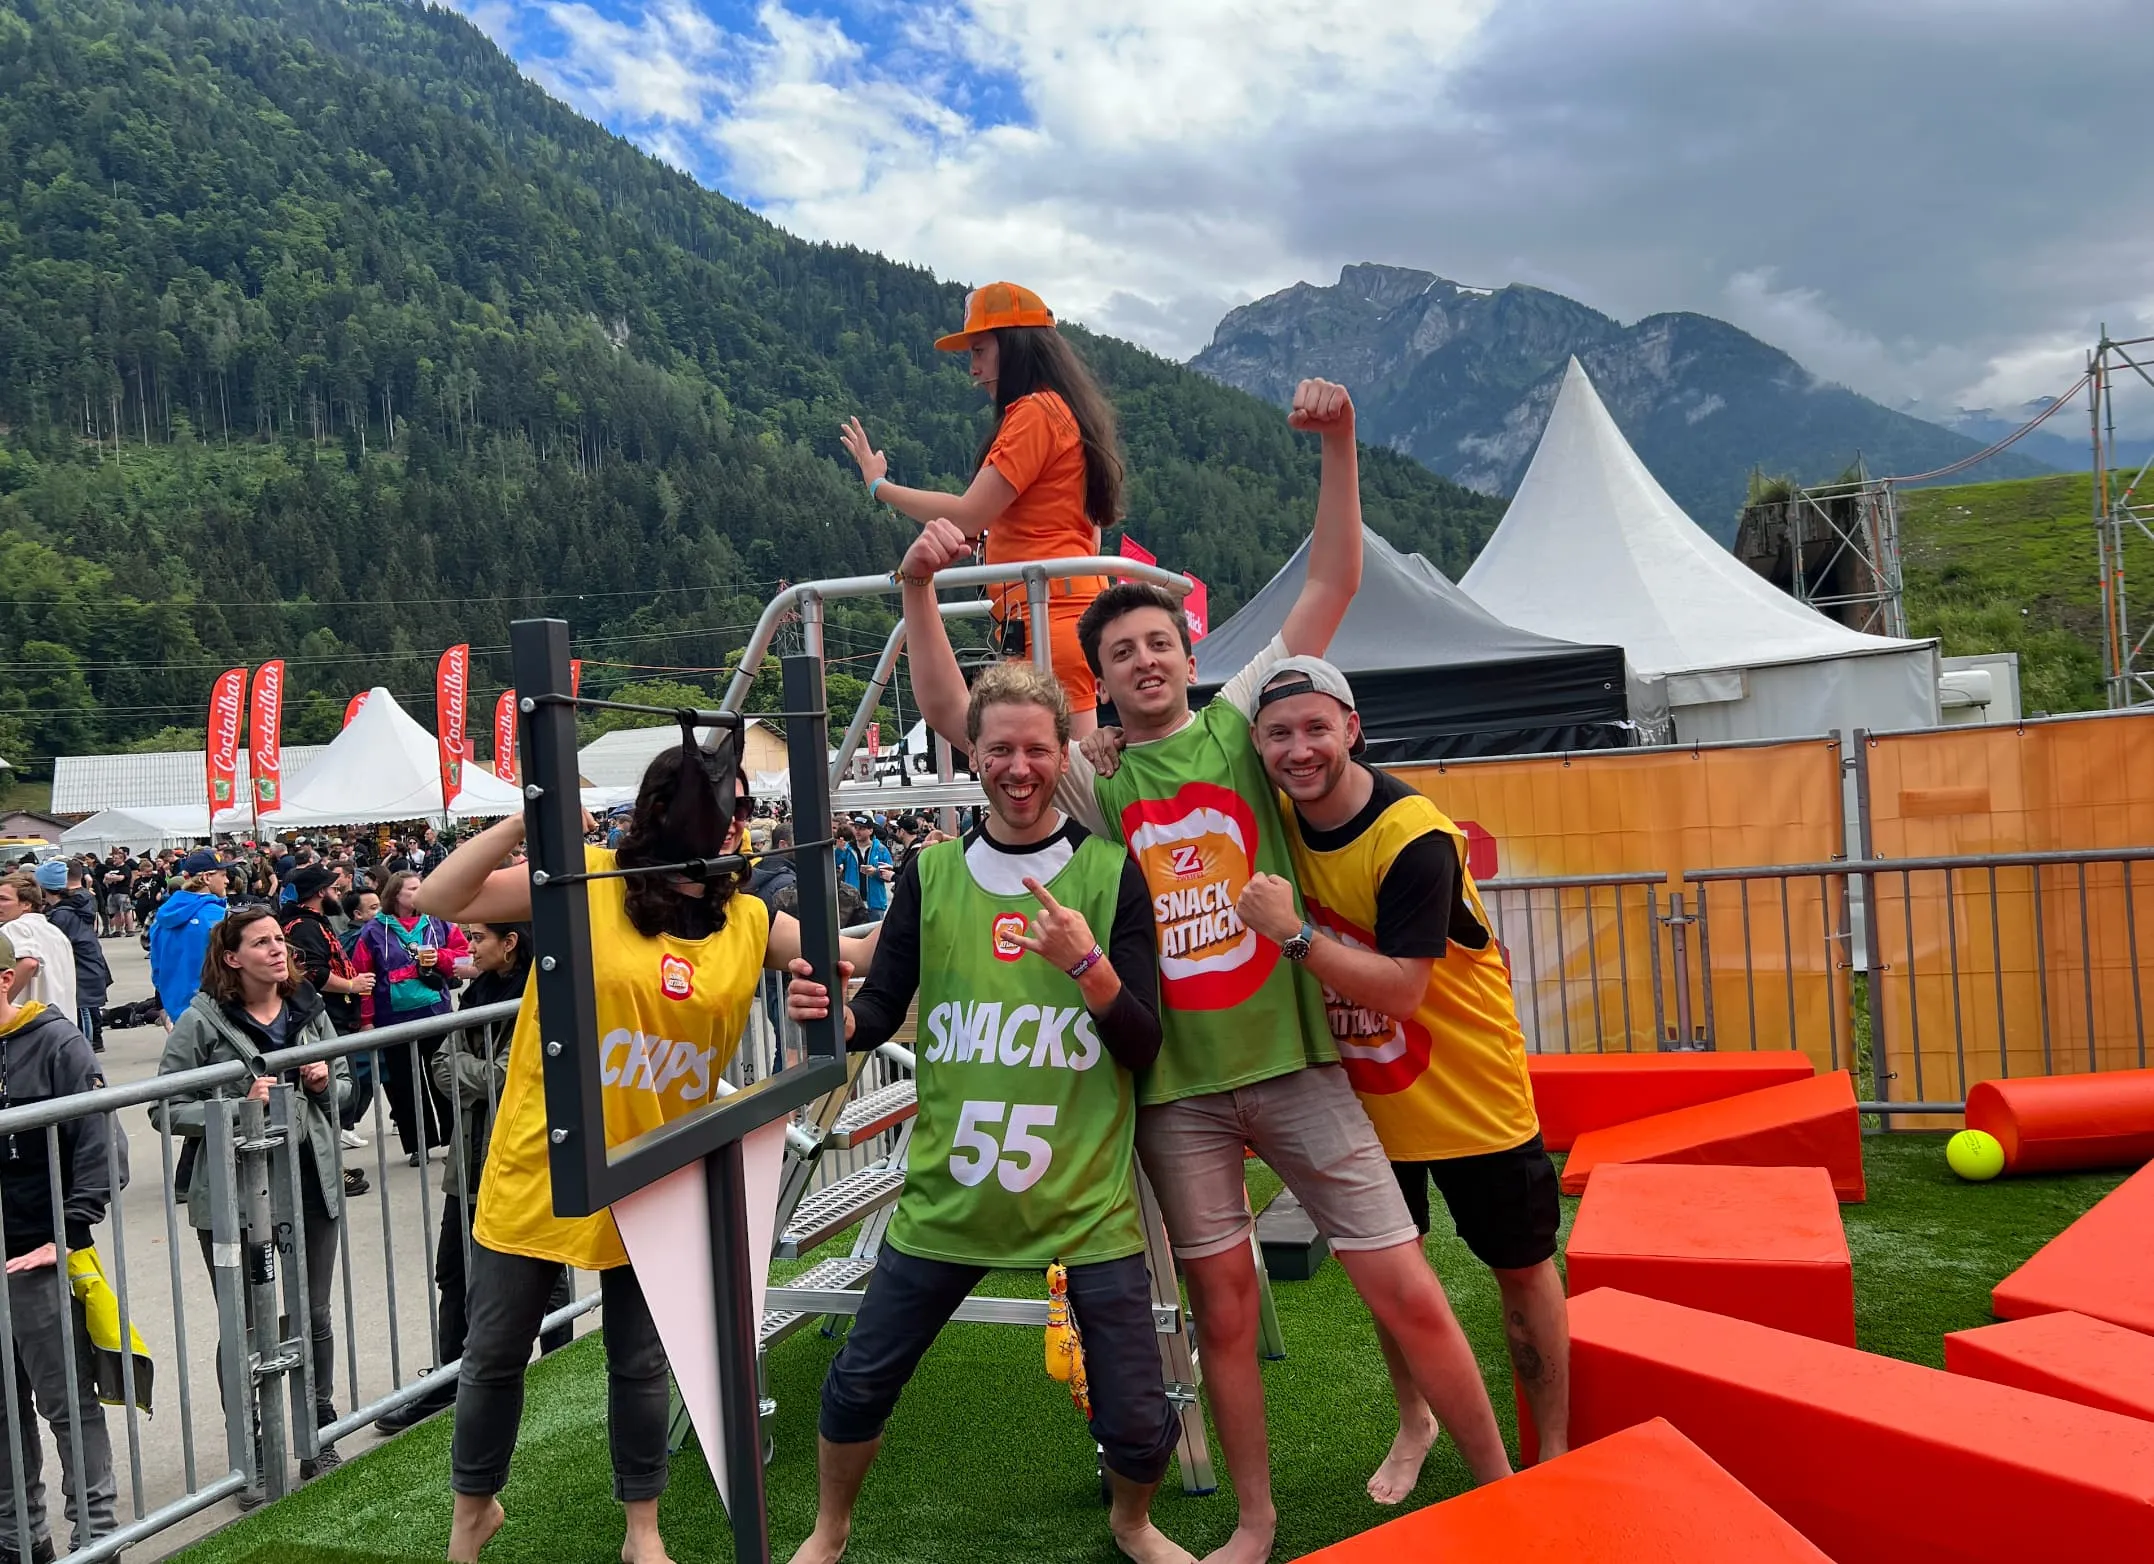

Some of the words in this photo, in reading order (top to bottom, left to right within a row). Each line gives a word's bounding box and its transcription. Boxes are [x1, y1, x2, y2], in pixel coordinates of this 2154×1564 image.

[213, 673, 241, 772] Coctailbar
[256, 665, 280, 772] Coctailbar
[443, 649, 464, 755] Coctailbar
[498, 693, 516, 784] Coctailbar
[1154, 879, 1233, 923] SNACK
[1171, 845, 1203, 875] Z
[1161, 904, 1246, 958] ATTACK
[600, 1027, 717, 1100] CHIPS
[925, 999, 1102, 1072] SNACKS
[949, 1100, 1058, 1193] 55
